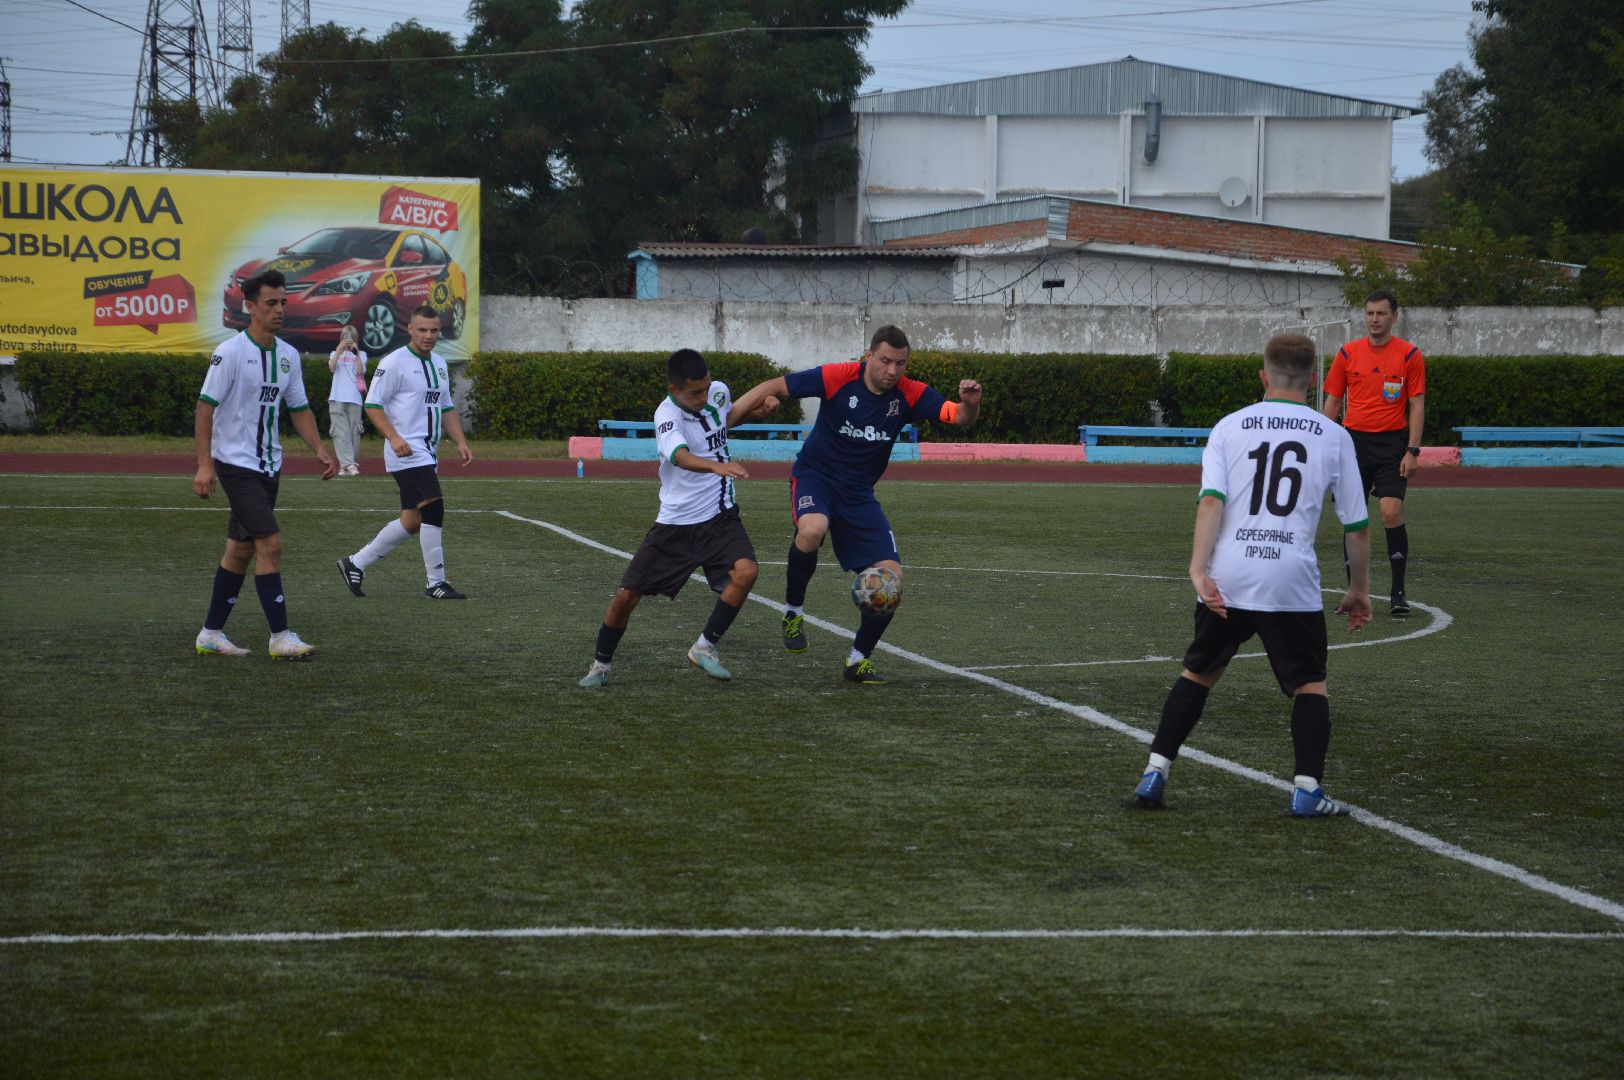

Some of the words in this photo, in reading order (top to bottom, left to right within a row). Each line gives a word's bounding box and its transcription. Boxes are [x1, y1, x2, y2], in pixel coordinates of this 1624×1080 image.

[0, 181, 183, 224] ШКОЛА
[88, 275, 144, 291] ОБУЧЕНИЕ
[115, 294, 174, 317] 5000
[1241, 416, 1264, 430] ФК
[1267, 416, 1323, 436] ЮНОСТЬ
[1248, 440, 1308, 517] 16
[1235, 528, 1294, 544] СЕРЕБРЯНЫЕ
[1245, 546, 1281, 560] ПРУДЫ
